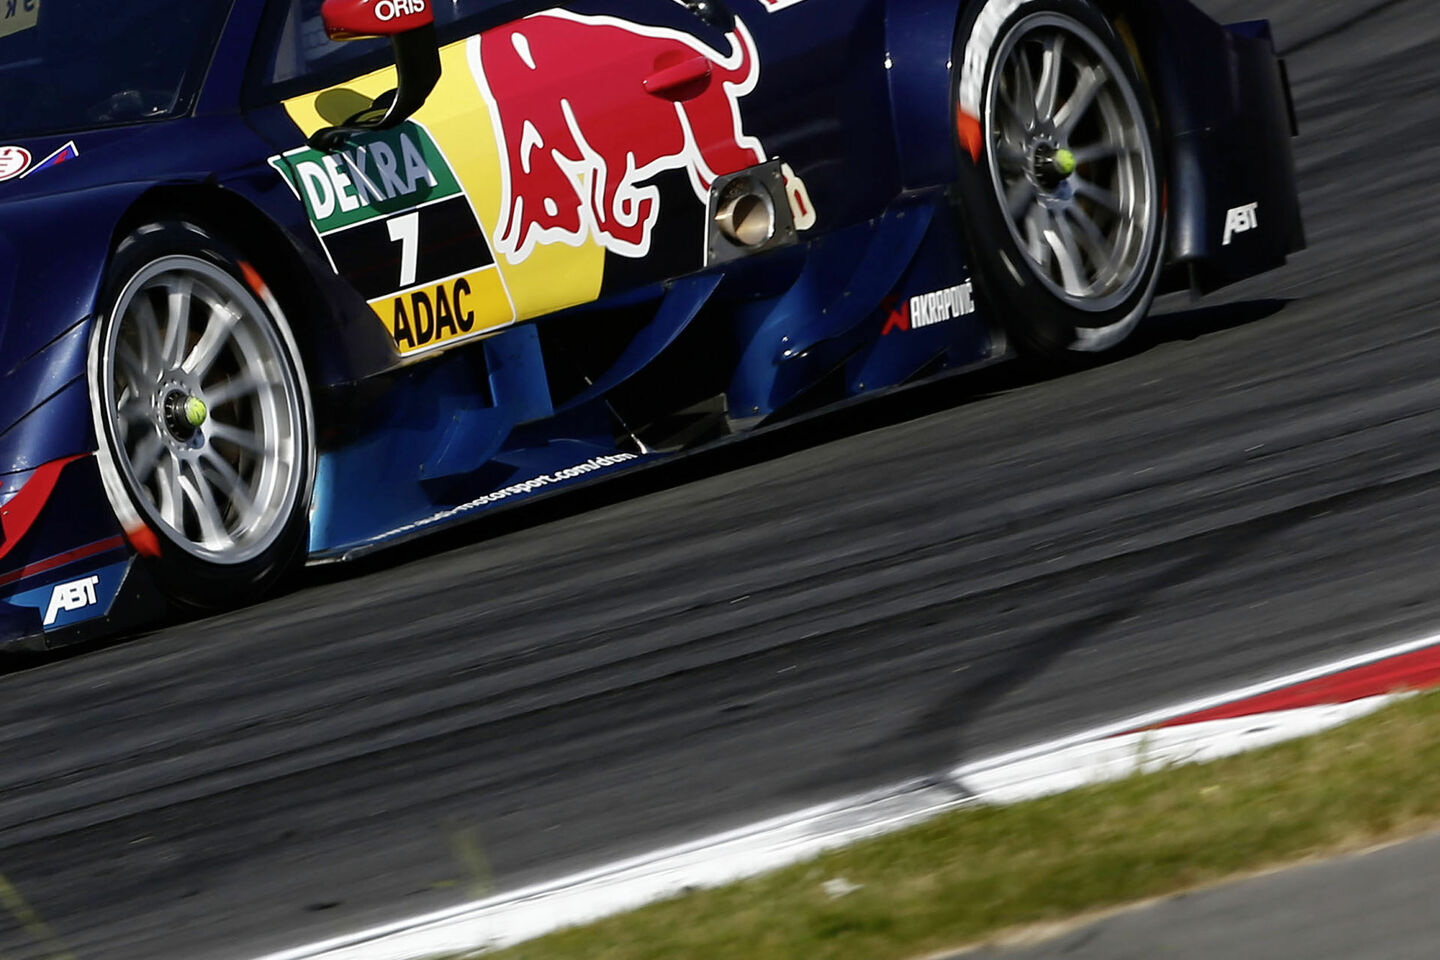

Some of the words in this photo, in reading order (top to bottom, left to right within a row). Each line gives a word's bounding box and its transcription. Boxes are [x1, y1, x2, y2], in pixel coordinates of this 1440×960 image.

[296, 133, 438, 220] DEKRA
[386, 211, 419, 287] 7
[1222, 201, 1258, 246] ABT
[393, 277, 475, 348] ADAC
[42, 574, 100, 627] ABT
